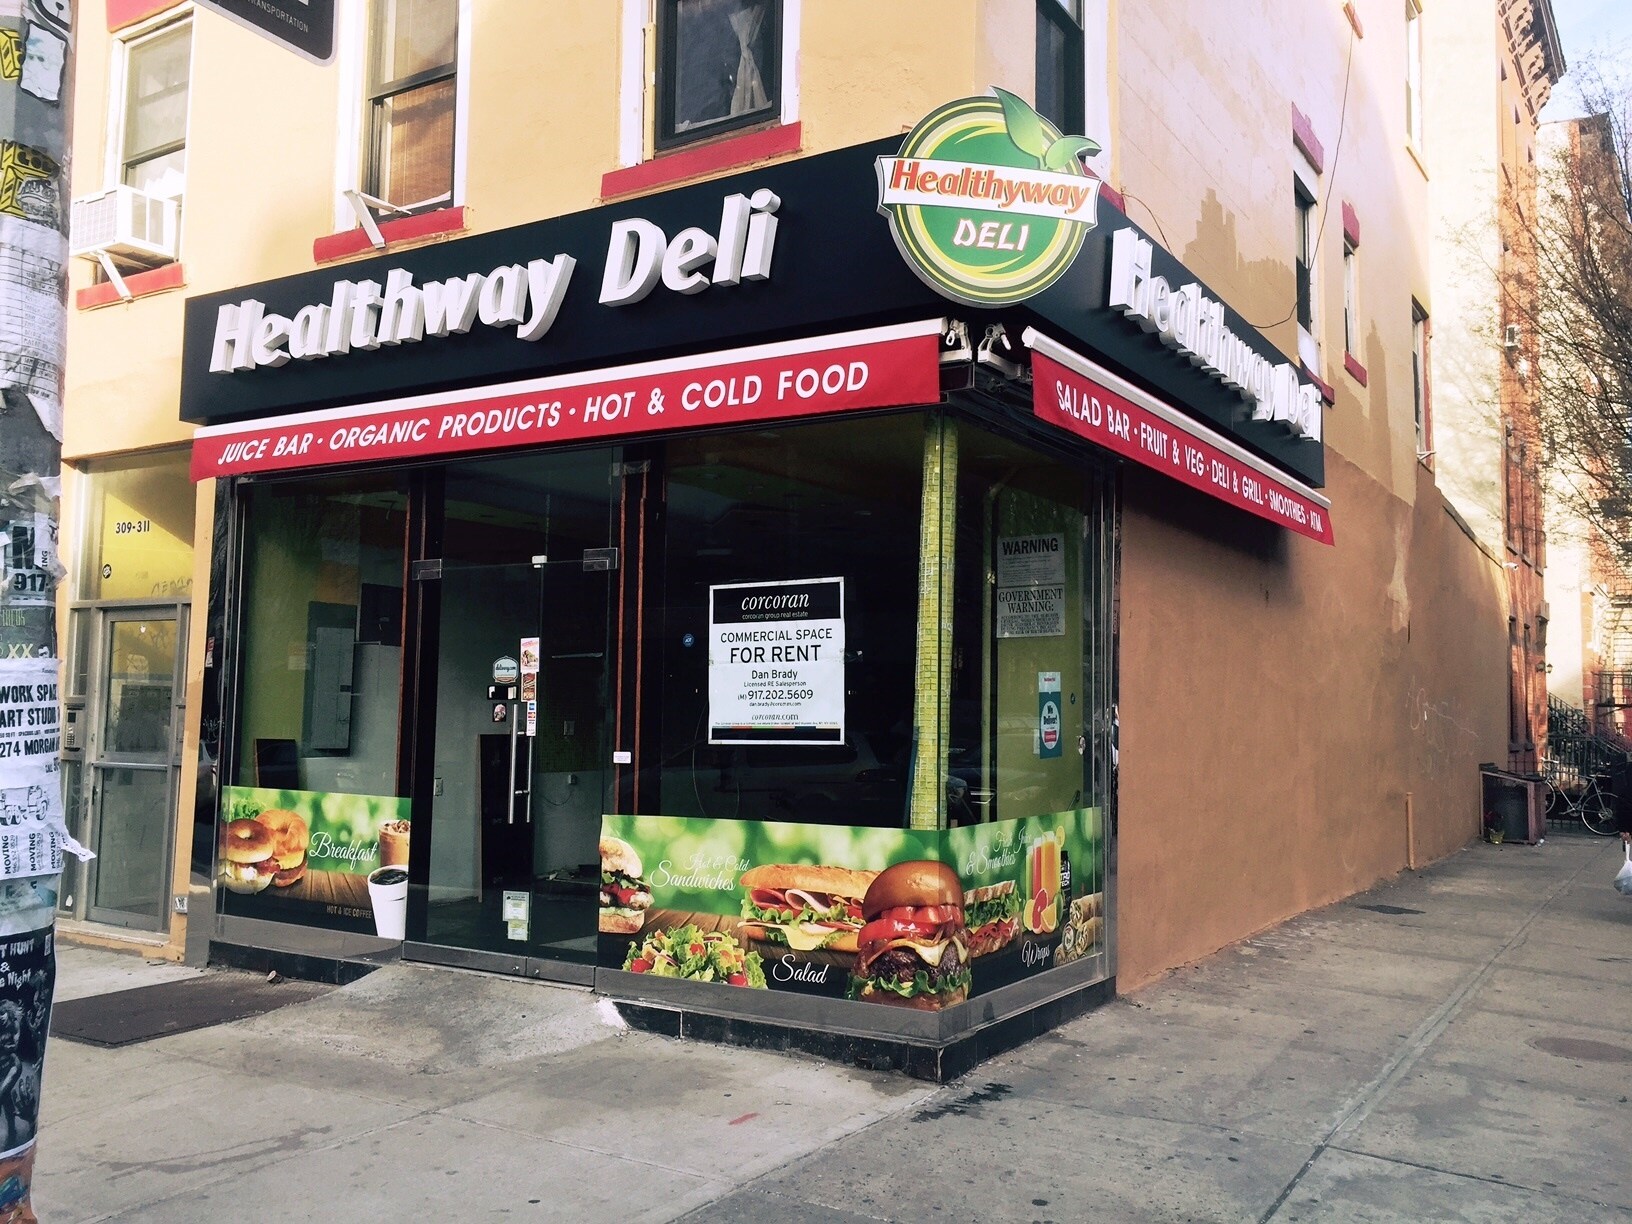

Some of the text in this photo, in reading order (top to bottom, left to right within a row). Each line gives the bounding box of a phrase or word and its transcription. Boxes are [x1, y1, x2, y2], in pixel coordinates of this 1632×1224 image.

[889, 159, 1091, 215] Healthyway
[953, 218, 1030, 251] DELI
[209, 188, 783, 375] Healthway Deli
[218, 361, 869, 465] JUICE BAR ORGANIC PRODUCTS HOT & COLD FOOD
[1056, 380, 1102, 427] SALAD
[1107, 404, 1130, 442] BAR
[1140, 421, 1168, 459] FRUIT
[1172, 439, 1180, 465] &
[1184, 444, 1205, 476] VEG
[1211, 459, 1230, 490] DELI
[1232, 470, 1239, 494] &
[1242, 475, 1264, 505] GRILL
[1268, 488, 1307, 525] SMOOTHIES
[115, 520, 150, 534] 309-311
[1002, 537, 1059, 555] WARNING
[741, 592, 810, 611] corcoran
[998, 588, 1063, 603] GOVERNMENT
[791, 610, 809, 618] estate
[1007, 601, 1054, 614] WARNING:
[720, 628, 833, 643] COMMERCIAL SPACE
[730, 644, 822, 663] FOR RENT
[751, 669, 798, 681] Dan Brady
[0, 684, 34, 704] WORK
[747, 689, 814, 700] 917.202.5609
[0, 709, 24, 728] ART
[0, 741, 21, 758] 274
[2, 835, 11, 874] MOVING
[29, 832, 37, 871] MOVING
[308, 831, 378, 871] Breakfast
[724, 855, 750, 872] Cold
[650, 860, 735, 891] Sandwiches
[352, 908, 372, 918] COFFEE
[10, 938, 35, 957] HUNT
[1022, 939, 1050, 968] Wraps
[772, 953, 829, 984] Salad
[7, 968, 31, 991] Night
